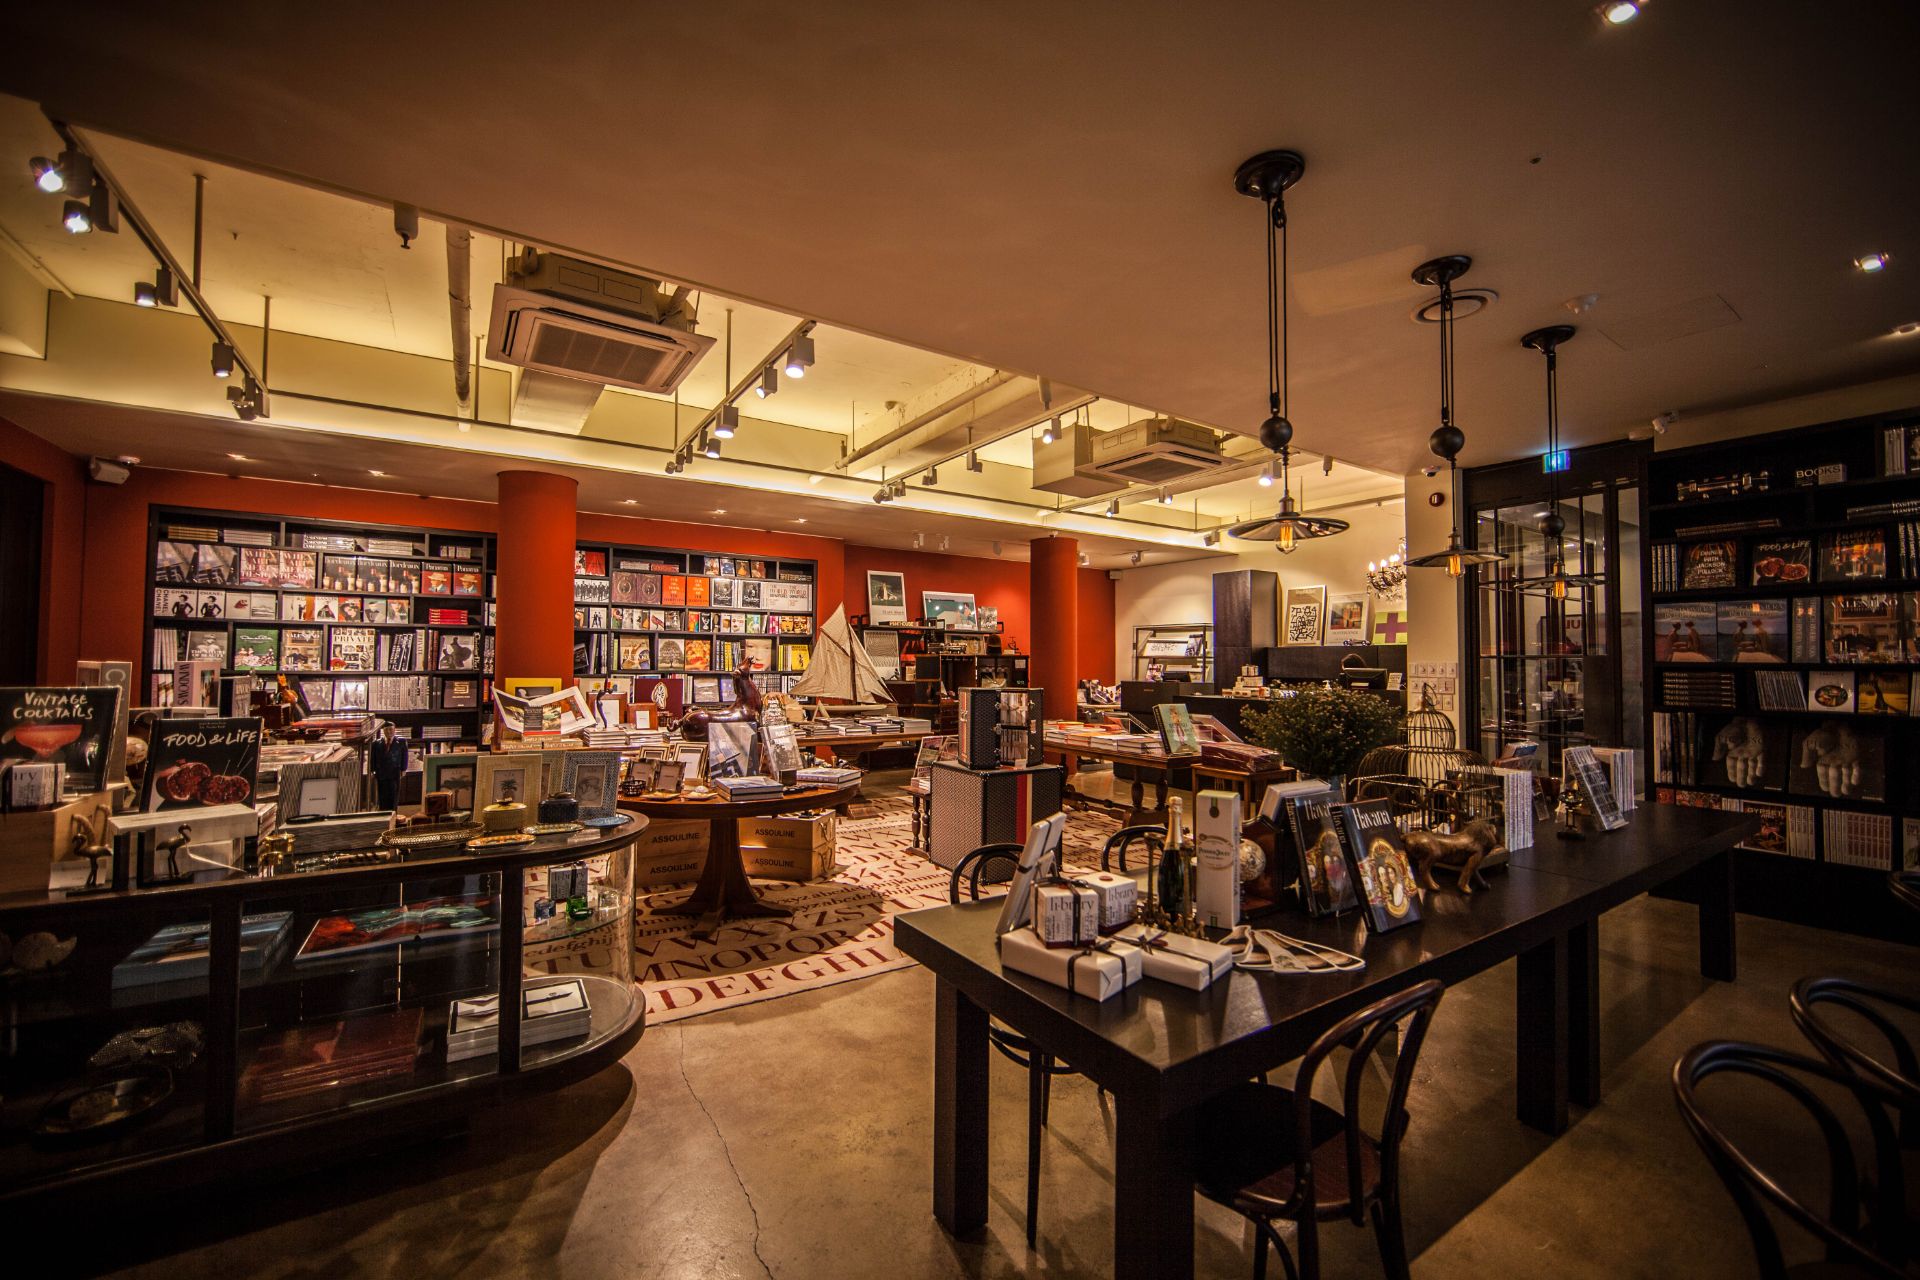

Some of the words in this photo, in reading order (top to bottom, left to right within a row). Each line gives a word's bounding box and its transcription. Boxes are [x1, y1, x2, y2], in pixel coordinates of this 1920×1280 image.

[1795, 465, 1841, 480] BOOKS
[1831, 598, 1899, 610] VALENTINO
[333, 635, 374, 643] PRIVATE
[177, 662, 190, 706] WINDOWS
[24, 691, 89, 707] VINTAGE
[13, 707, 94, 720] COCKTAILS
[163, 732, 207, 748] FOOD
[209, 734, 224, 745] &
[226, 729, 258, 745] LIFE
[1303, 799, 1341, 821] Hava
[1351, 807, 1394, 831] Havana
[651, 832, 700, 843] ASSOULINE
[755, 828, 796, 838] ASSOULINE
[650, 862, 698, 874] ASSOULINE
[755, 858, 795, 868] ASSOULINE
